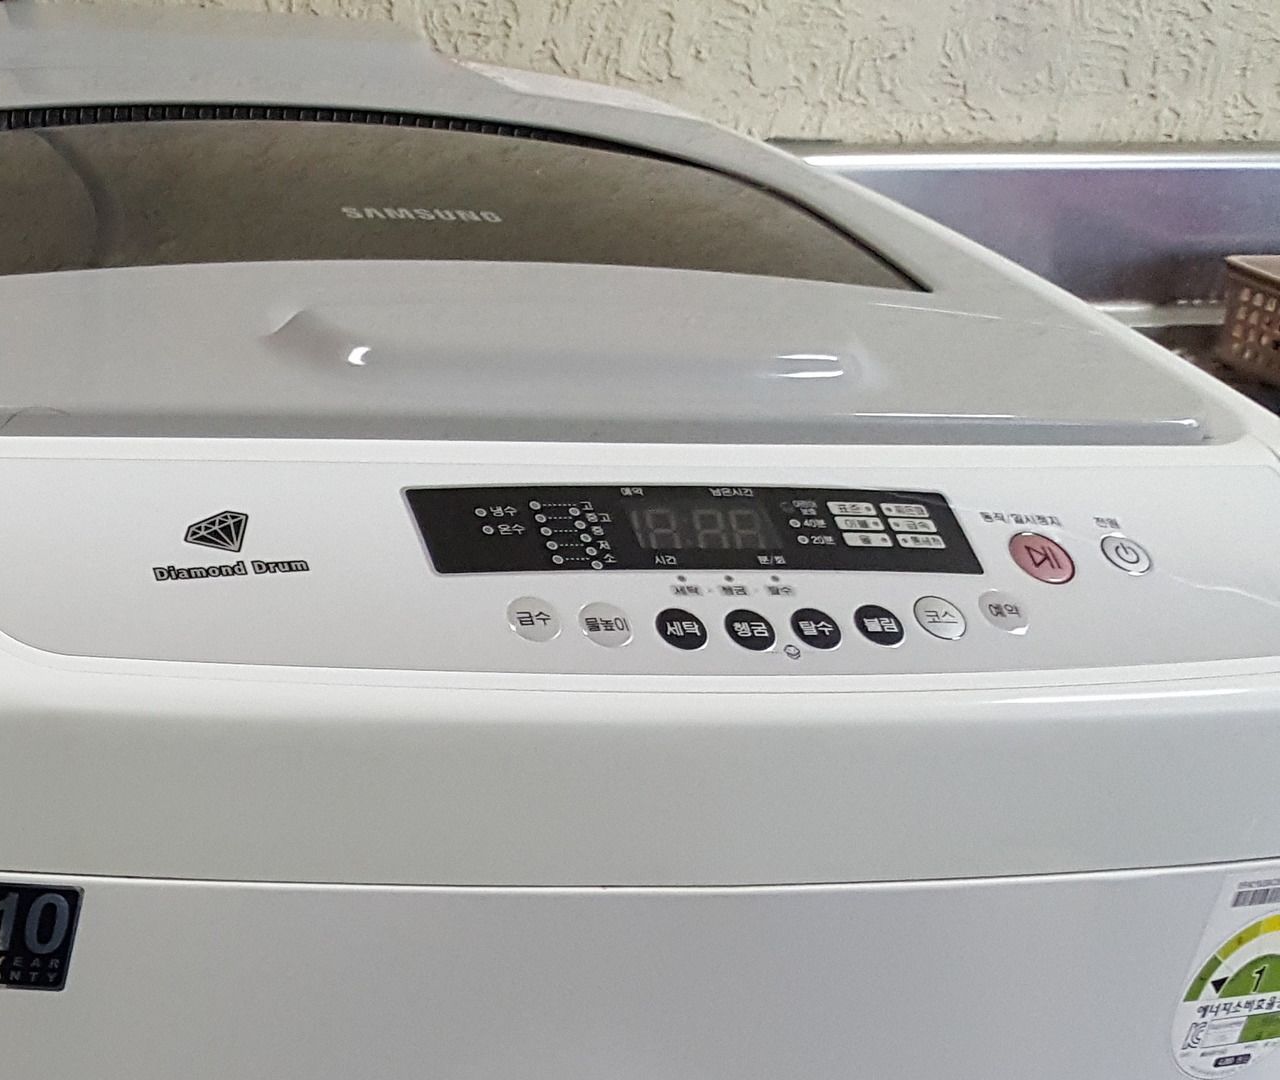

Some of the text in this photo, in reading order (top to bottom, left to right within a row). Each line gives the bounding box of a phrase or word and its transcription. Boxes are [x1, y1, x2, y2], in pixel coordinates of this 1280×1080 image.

[341, 206, 502, 223] SAMSUNG
[490, 505, 518, 517] 냉수
[497, 523, 526, 535] 온수
[654, 554, 678, 566] 시간
[152, 559, 311, 582] Diamond Drum
[515, 610, 552, 627] 급수
[924, 609, 959, 624] 코스
[987, 603, 1021, 618] 예약
[584, 616, 630, 633] 물높이
[665, 621, 702, 638] 세탁
[732, 620, 769, 638] 헹굼
[798, 619, 834, 637] 탈수
[863, 616, 900, 633] 불림
[1251, 963, 1269, 994] 1
